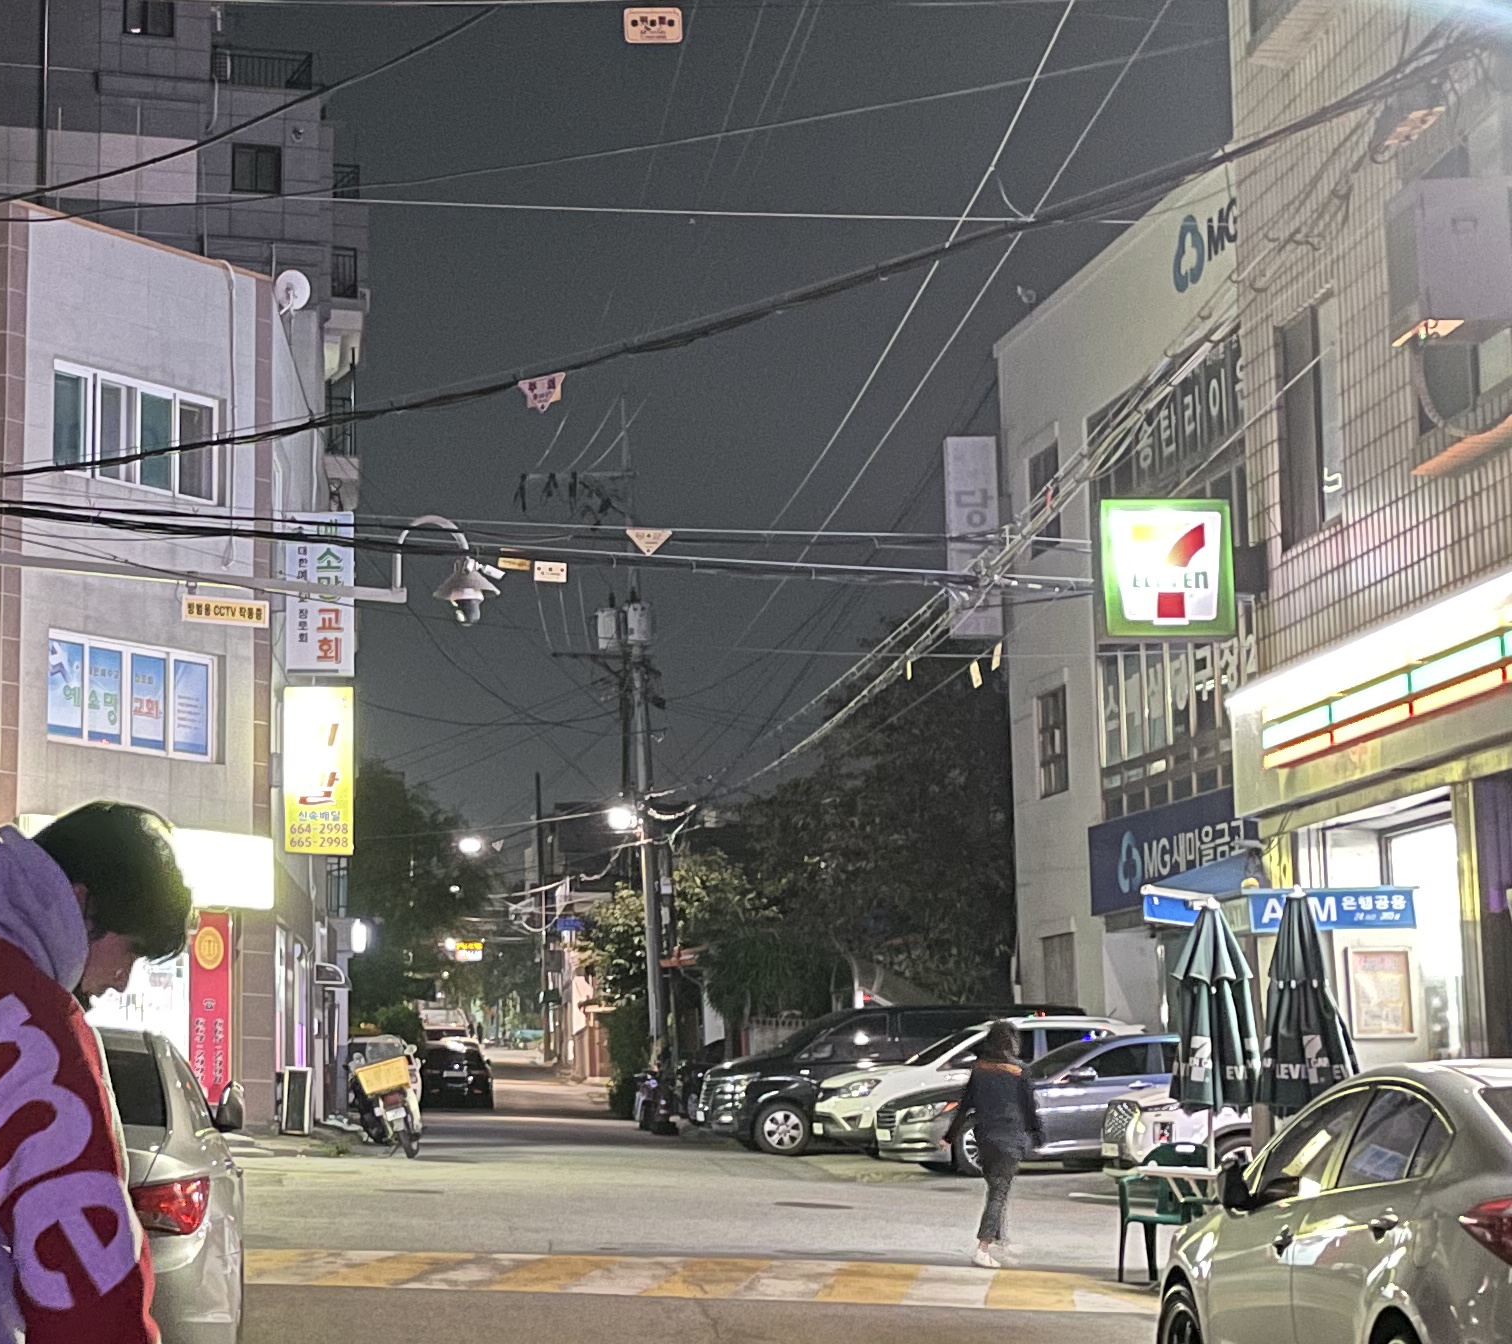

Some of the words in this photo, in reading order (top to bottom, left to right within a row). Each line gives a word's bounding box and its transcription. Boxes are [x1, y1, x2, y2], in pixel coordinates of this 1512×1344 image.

[213, 604, 237, 617] CCTV
[298, 810, 341, 822] 신속배달
[289, 823, 349, 835] 664-2998
[289, 836, 349, 848] 665-2998
[1262, 893, 1338, 924] AM
[1341, 894, 1407, 911] 은행공용
